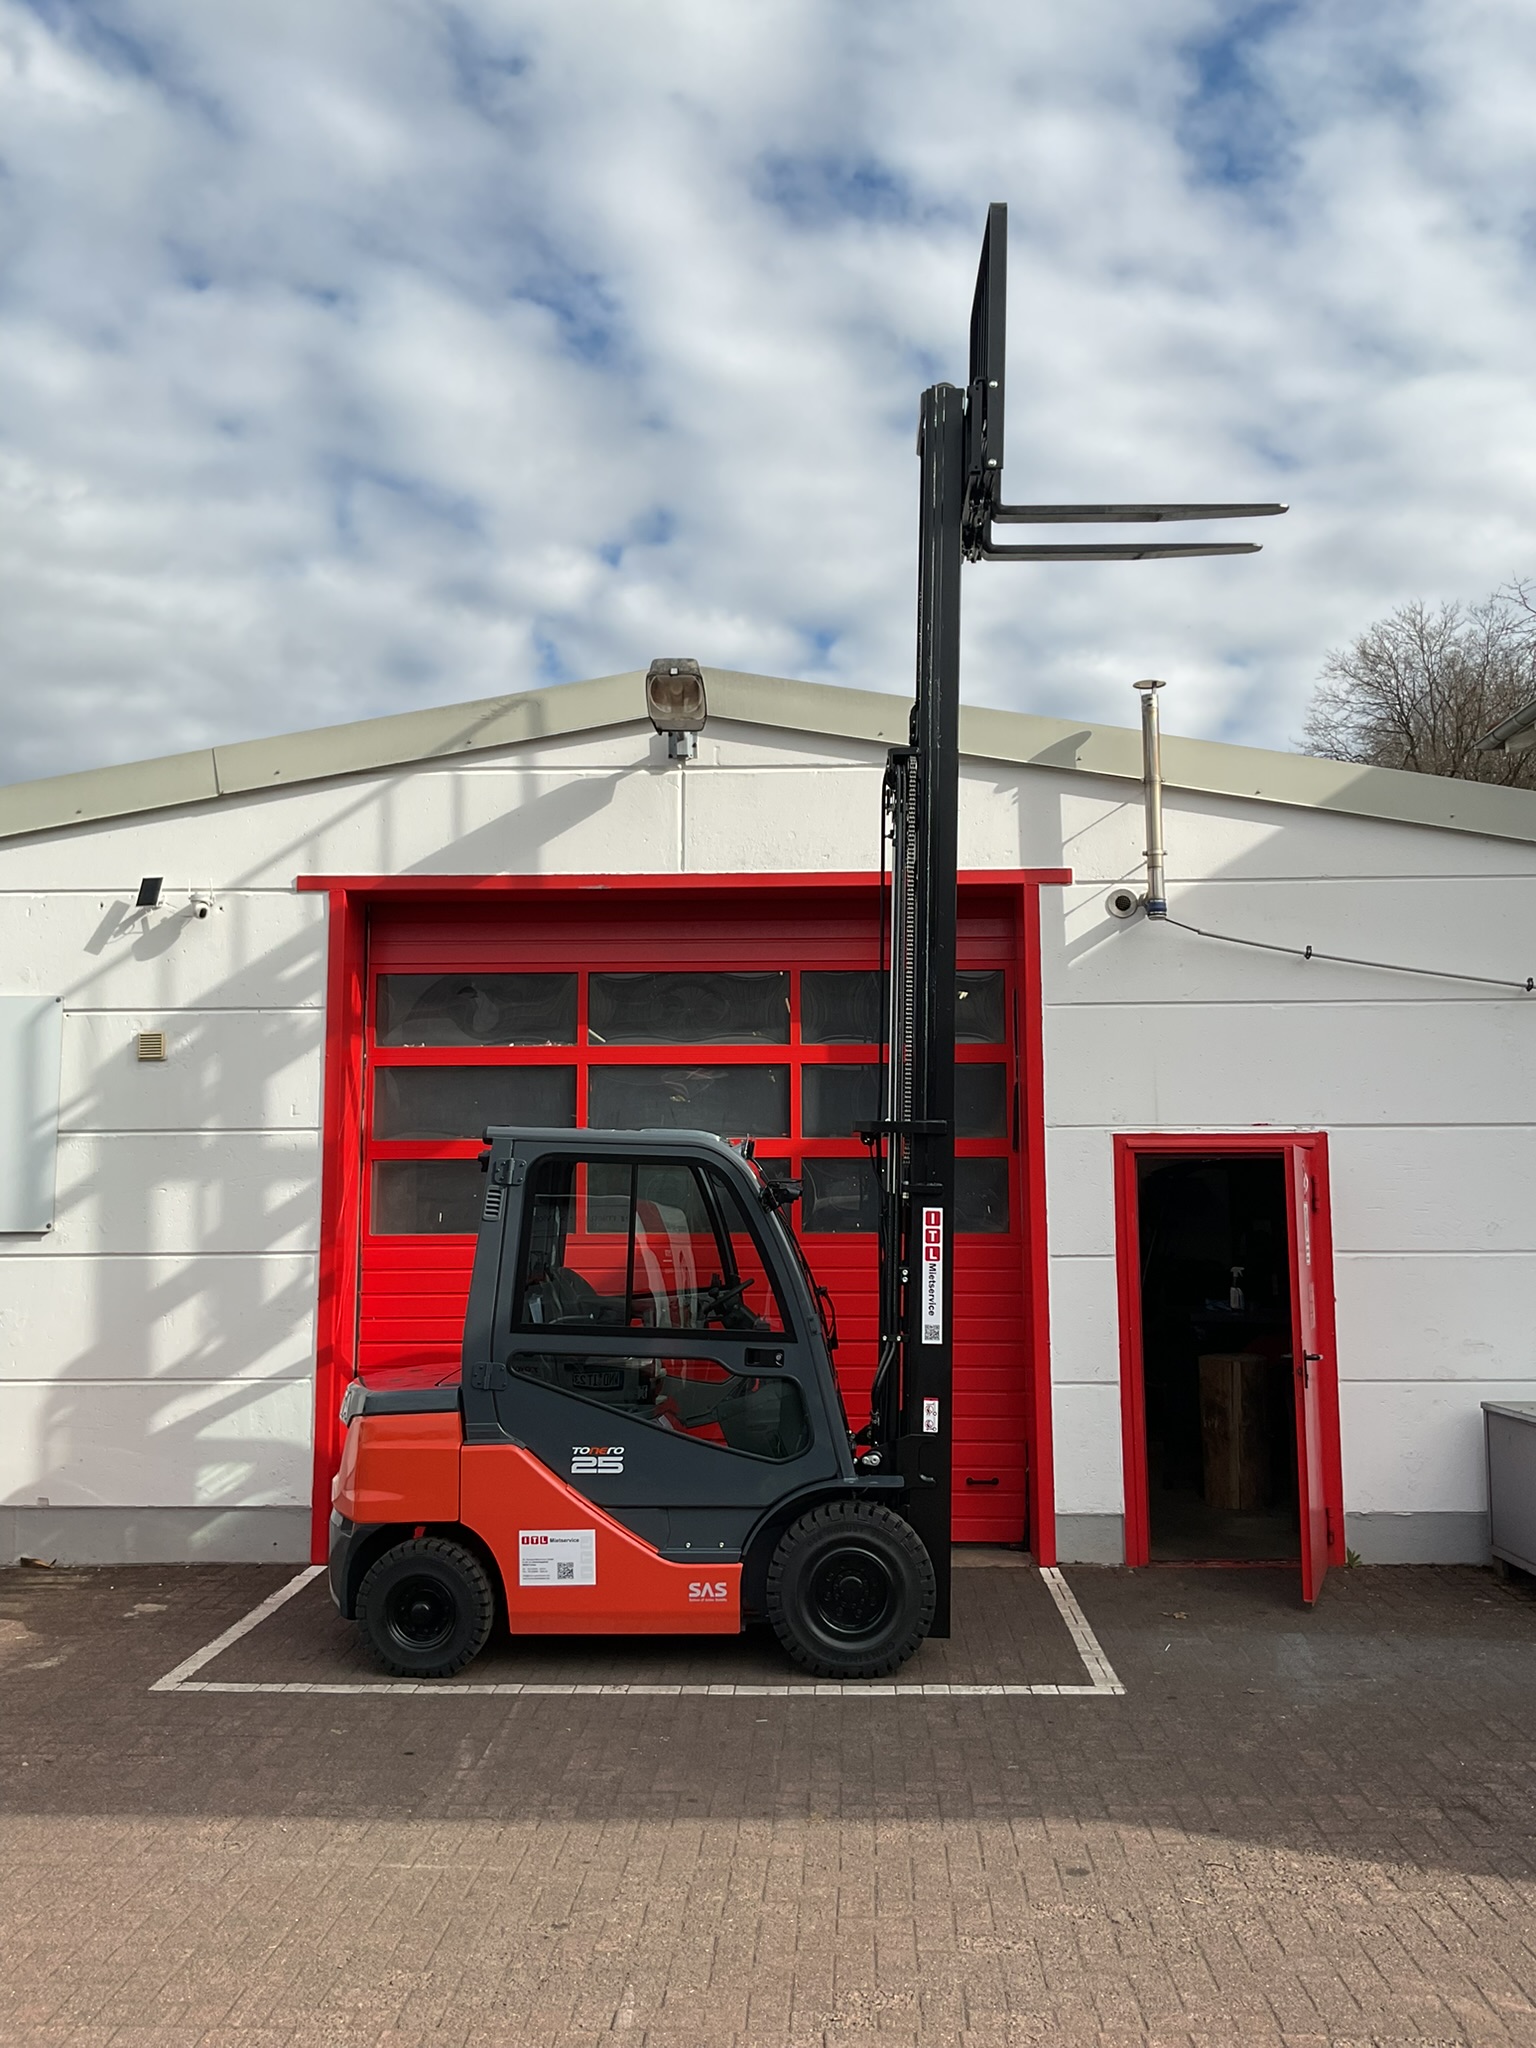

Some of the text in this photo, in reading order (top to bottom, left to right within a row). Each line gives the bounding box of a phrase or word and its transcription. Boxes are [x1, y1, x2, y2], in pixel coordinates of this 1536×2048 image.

[925, 1211, 940, 1316] ITL Mietservice
[571, 1456, 624, 1474] 25
[522, 1536, 548, 1545] ITL
[689, 1582, 728, 1598] SAS
